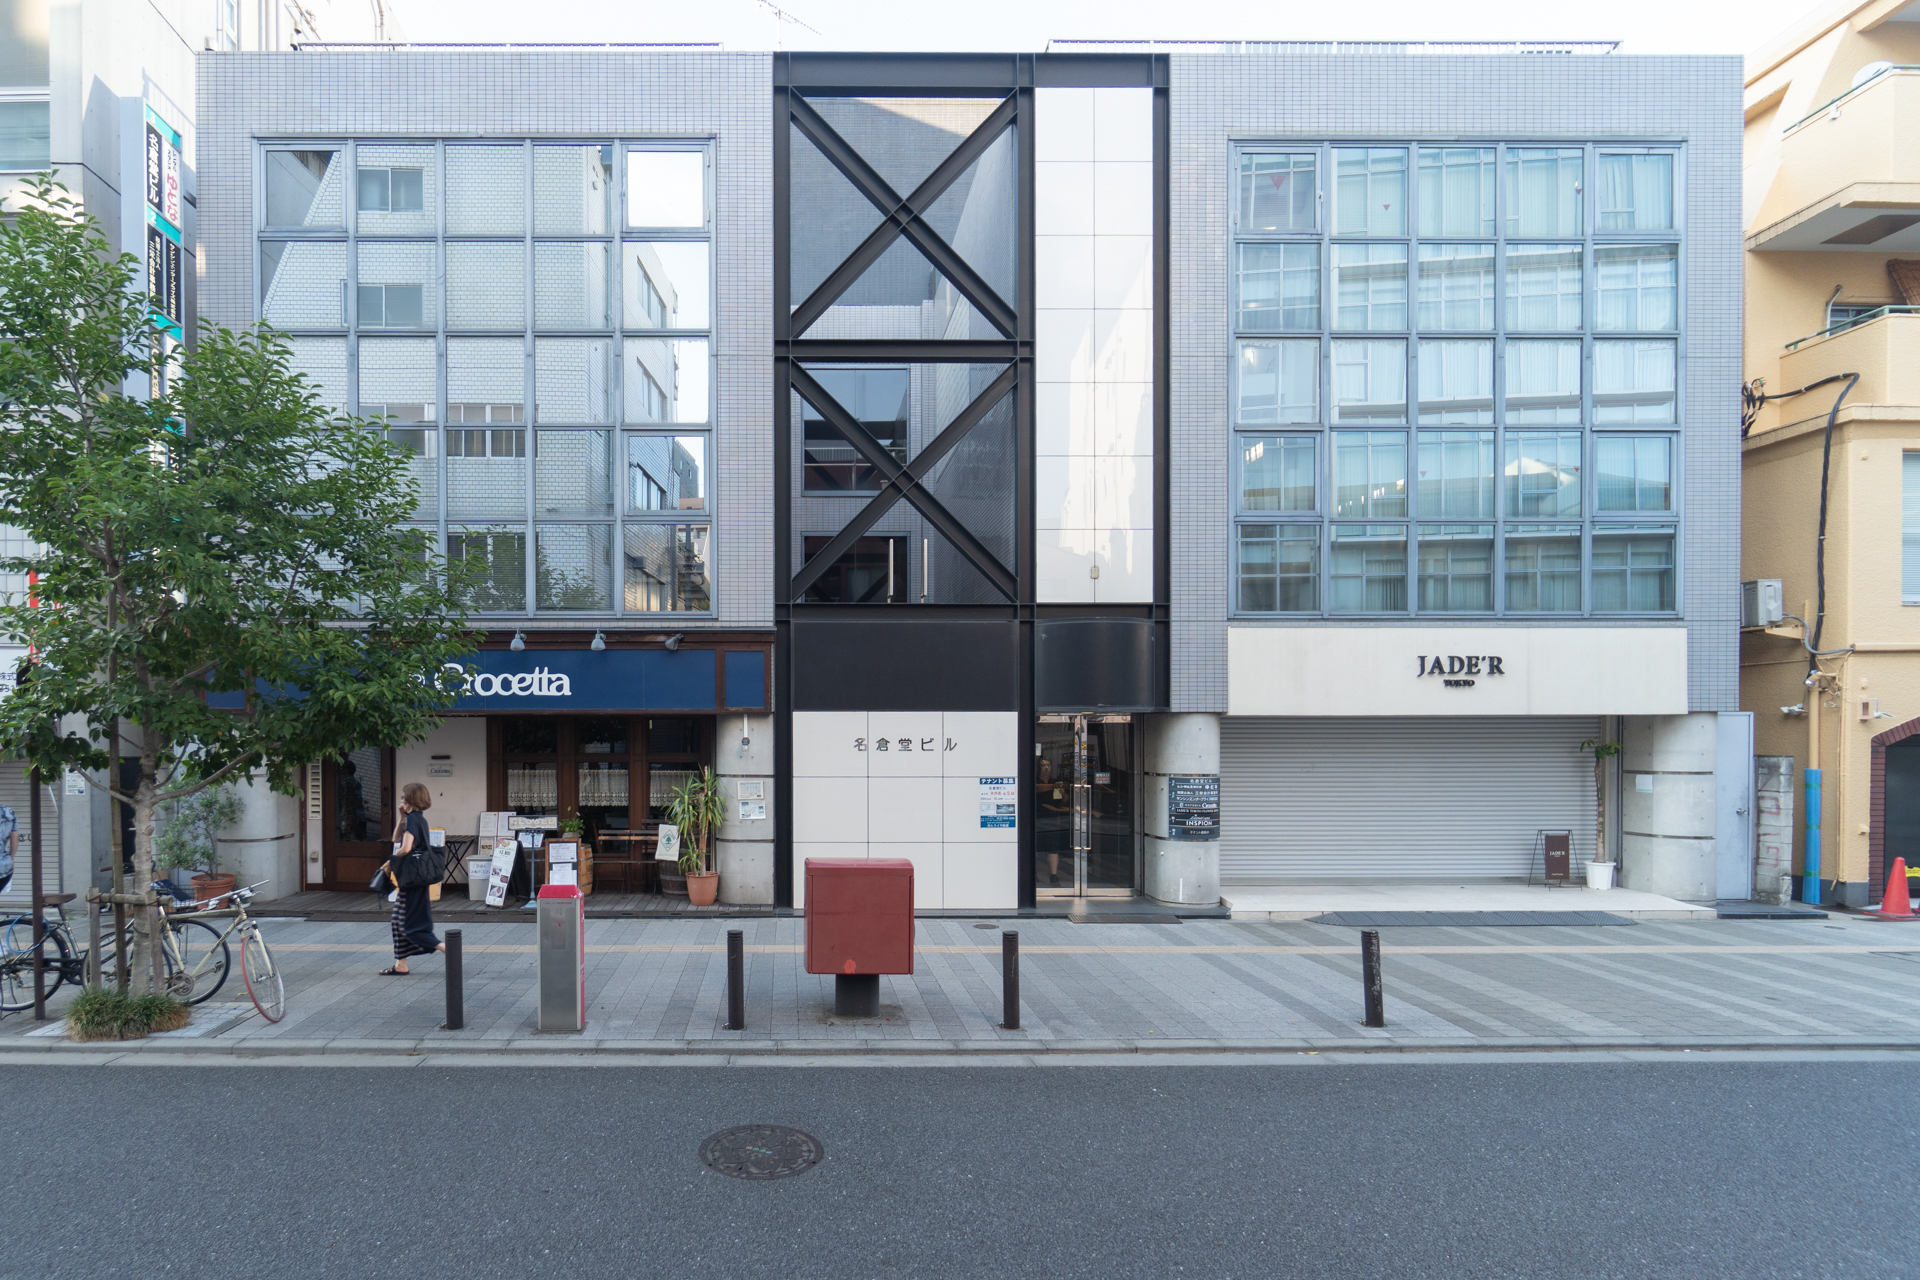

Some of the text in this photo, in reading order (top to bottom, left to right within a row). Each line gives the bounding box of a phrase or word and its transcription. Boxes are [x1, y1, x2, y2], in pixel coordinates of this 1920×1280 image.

[148, 133, 160, 203] 名倉堂ビル
[150, 211, 157, 224] 2
[1417, 655, 1505, 678] JADE'R
[434, 662, 572, 697] Crocetta
[1443, 679, 1476, 688] TOKYO
[853, 737, 958, 752] 名倉堂ビル
